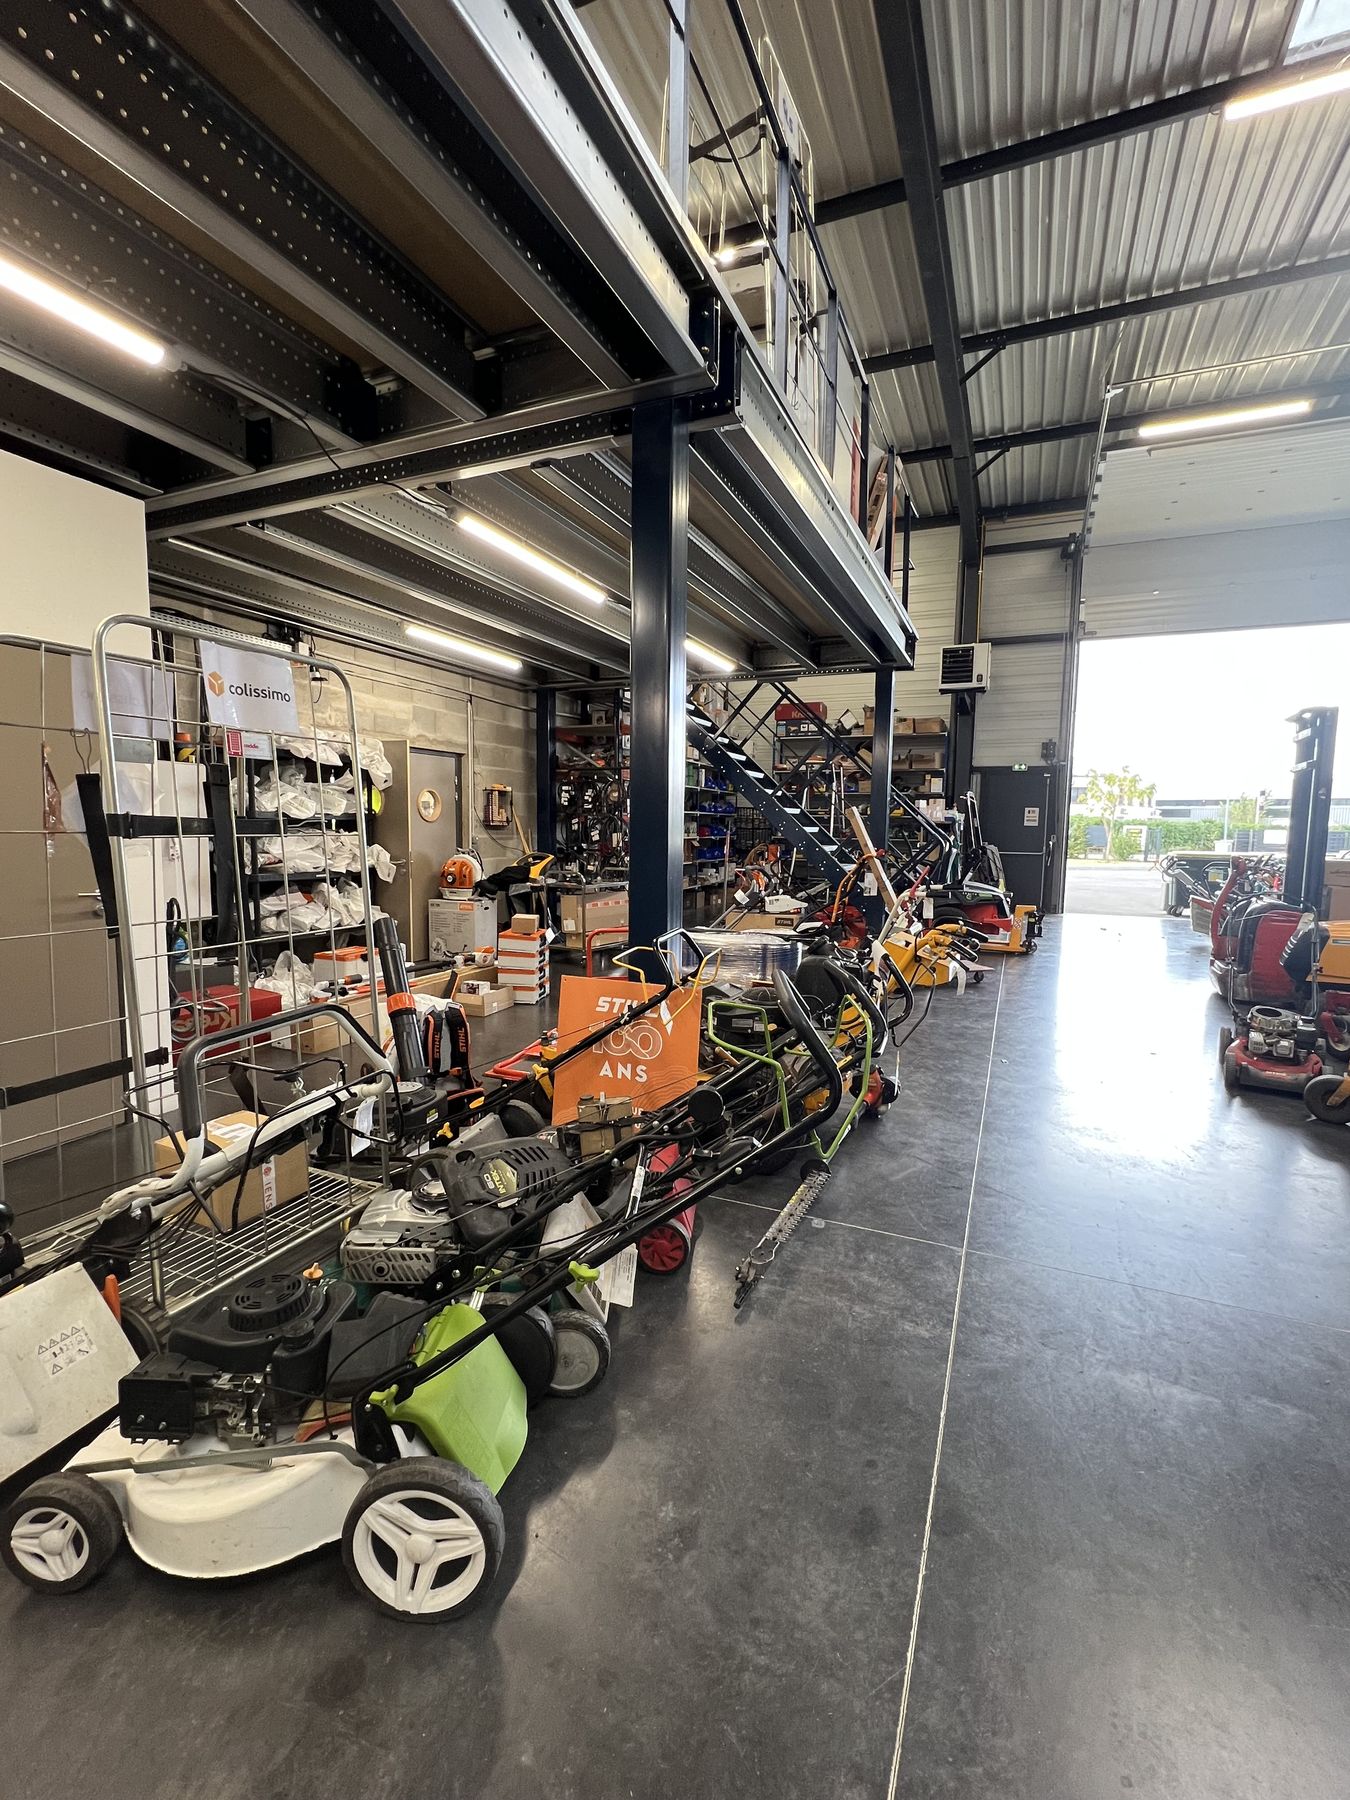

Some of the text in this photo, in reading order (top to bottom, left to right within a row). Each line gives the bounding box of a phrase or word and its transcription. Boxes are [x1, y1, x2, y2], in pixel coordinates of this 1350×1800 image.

[228, 683, 291, 703] colissimo
[433, 1031, 442, 1059] STIHL
[457, 1026, 467, 1053] STIHL
[599, 1060, 648, 1083] ANS
